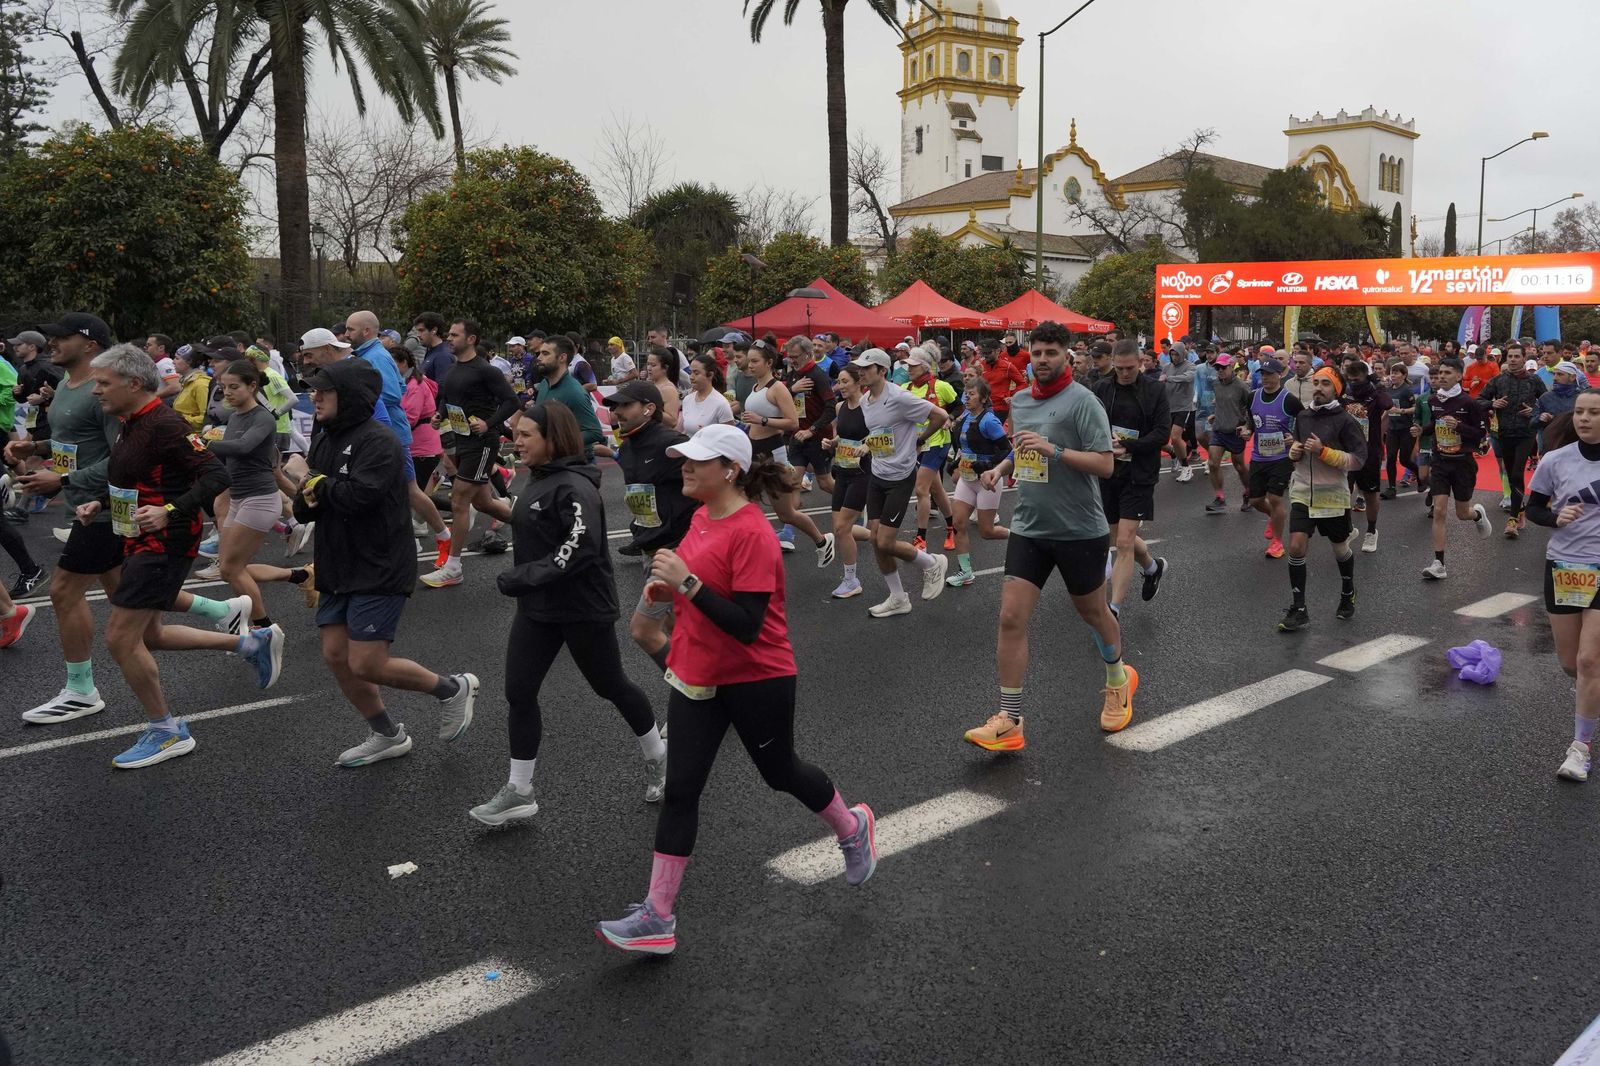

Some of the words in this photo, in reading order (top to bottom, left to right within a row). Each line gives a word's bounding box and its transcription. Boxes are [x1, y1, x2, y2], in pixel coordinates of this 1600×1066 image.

[1431, 266, 1503, 281] maratón
[1520, 273, 1585, 286] 00:11:16
[1236, 278, 1275, 289] Sprinter
[1314, 275, 1359, 291] HOKA
[1446, 277, 1507, 293] sevilla
[554, 502, 587, 569] adidas
[1556, 571, 1596, 588] 13602
